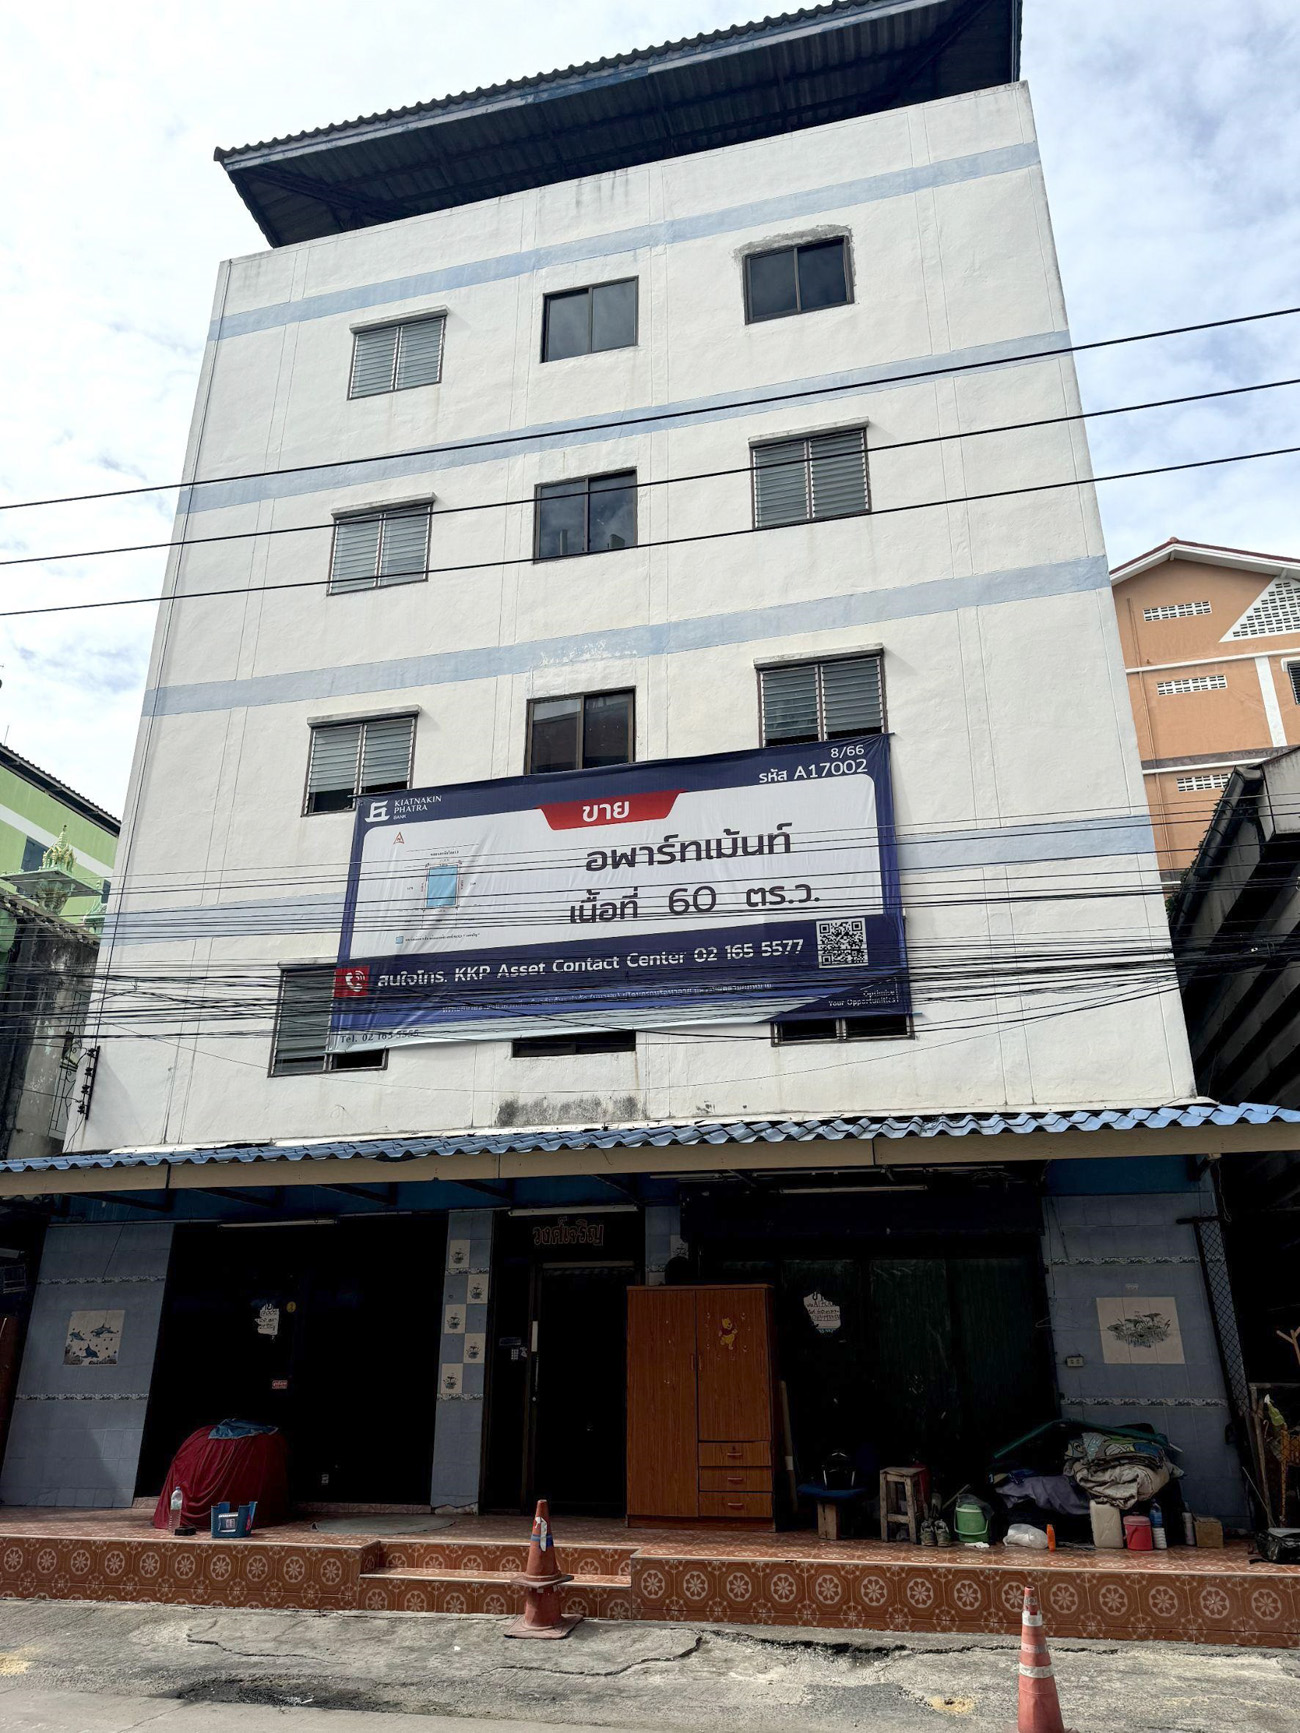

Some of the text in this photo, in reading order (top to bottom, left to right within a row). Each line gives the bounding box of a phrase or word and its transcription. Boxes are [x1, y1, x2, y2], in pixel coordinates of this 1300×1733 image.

[831, 745, 864, 758] 8/66
[759, 759, 868, 783] รหัส A17002
[394, 795, 442, 807] KIATNAKIN
[394, 804, 428, 814] PHATRA
[582, 801, 630, 822] ขาย
[585, 822, 792, 872] อพาร์ทเม้นท์
[569, 883, 820, 924] เนื้อที่ 60 ตร.ว.
[377, 939, 804, 987] สนใจโทร. KKP Asset Contact Center 02 165 5577
[341, 1034, 358, 1043] Tel.
[362, 1033, 374, 1042] 02
